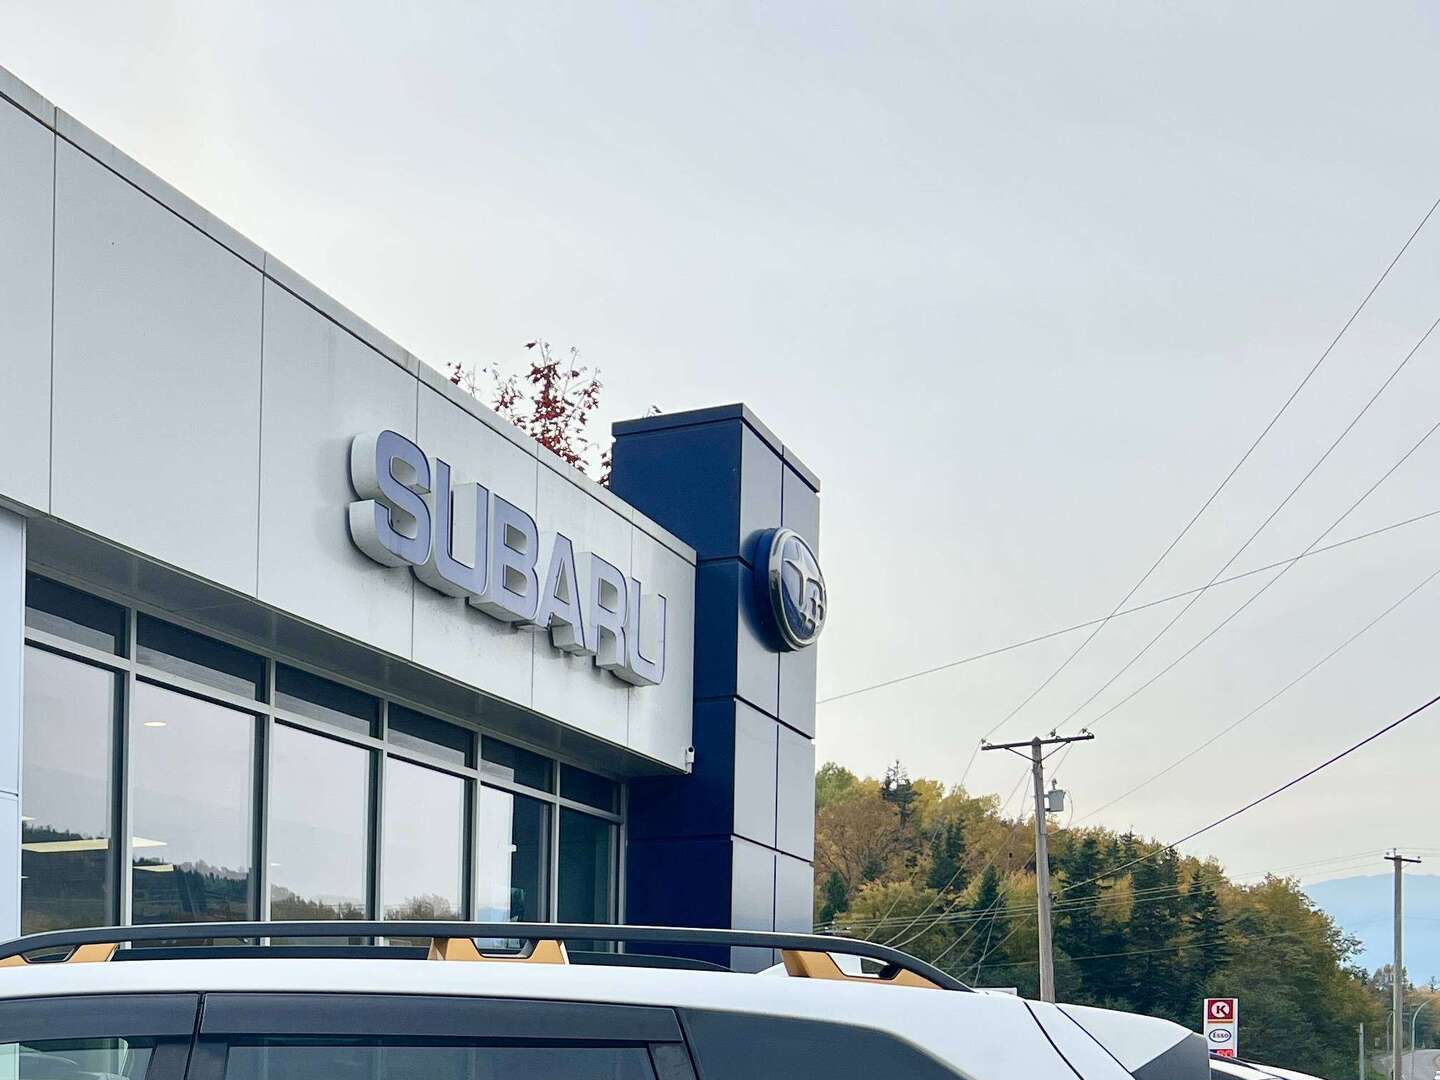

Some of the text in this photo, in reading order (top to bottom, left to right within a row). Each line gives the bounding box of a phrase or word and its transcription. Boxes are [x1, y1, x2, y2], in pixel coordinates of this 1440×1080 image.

[360, 430, 667, 686] SUBARU
[1216, 1005, 1228, 1016] K
[1212, 1031, 1229, 1039] Esso
